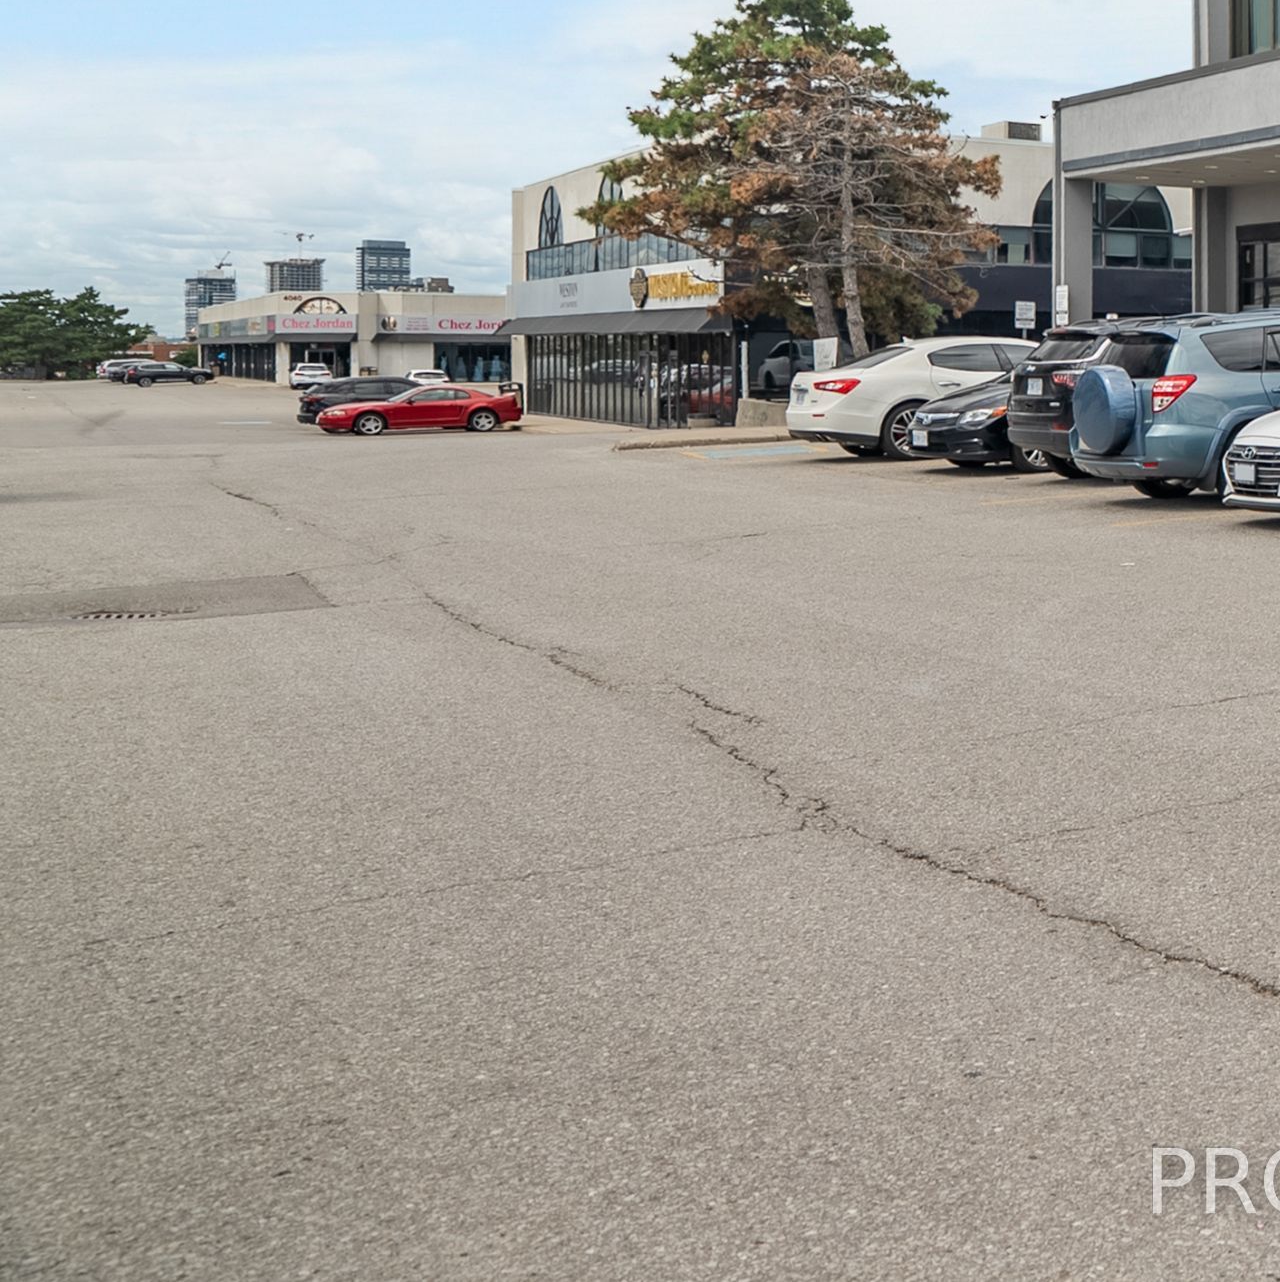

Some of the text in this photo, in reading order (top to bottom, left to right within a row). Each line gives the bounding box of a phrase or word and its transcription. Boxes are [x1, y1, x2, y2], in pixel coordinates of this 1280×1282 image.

[281, 317, 353, 329] Chez Jordan
[437, 318, 472, 330] Chez
